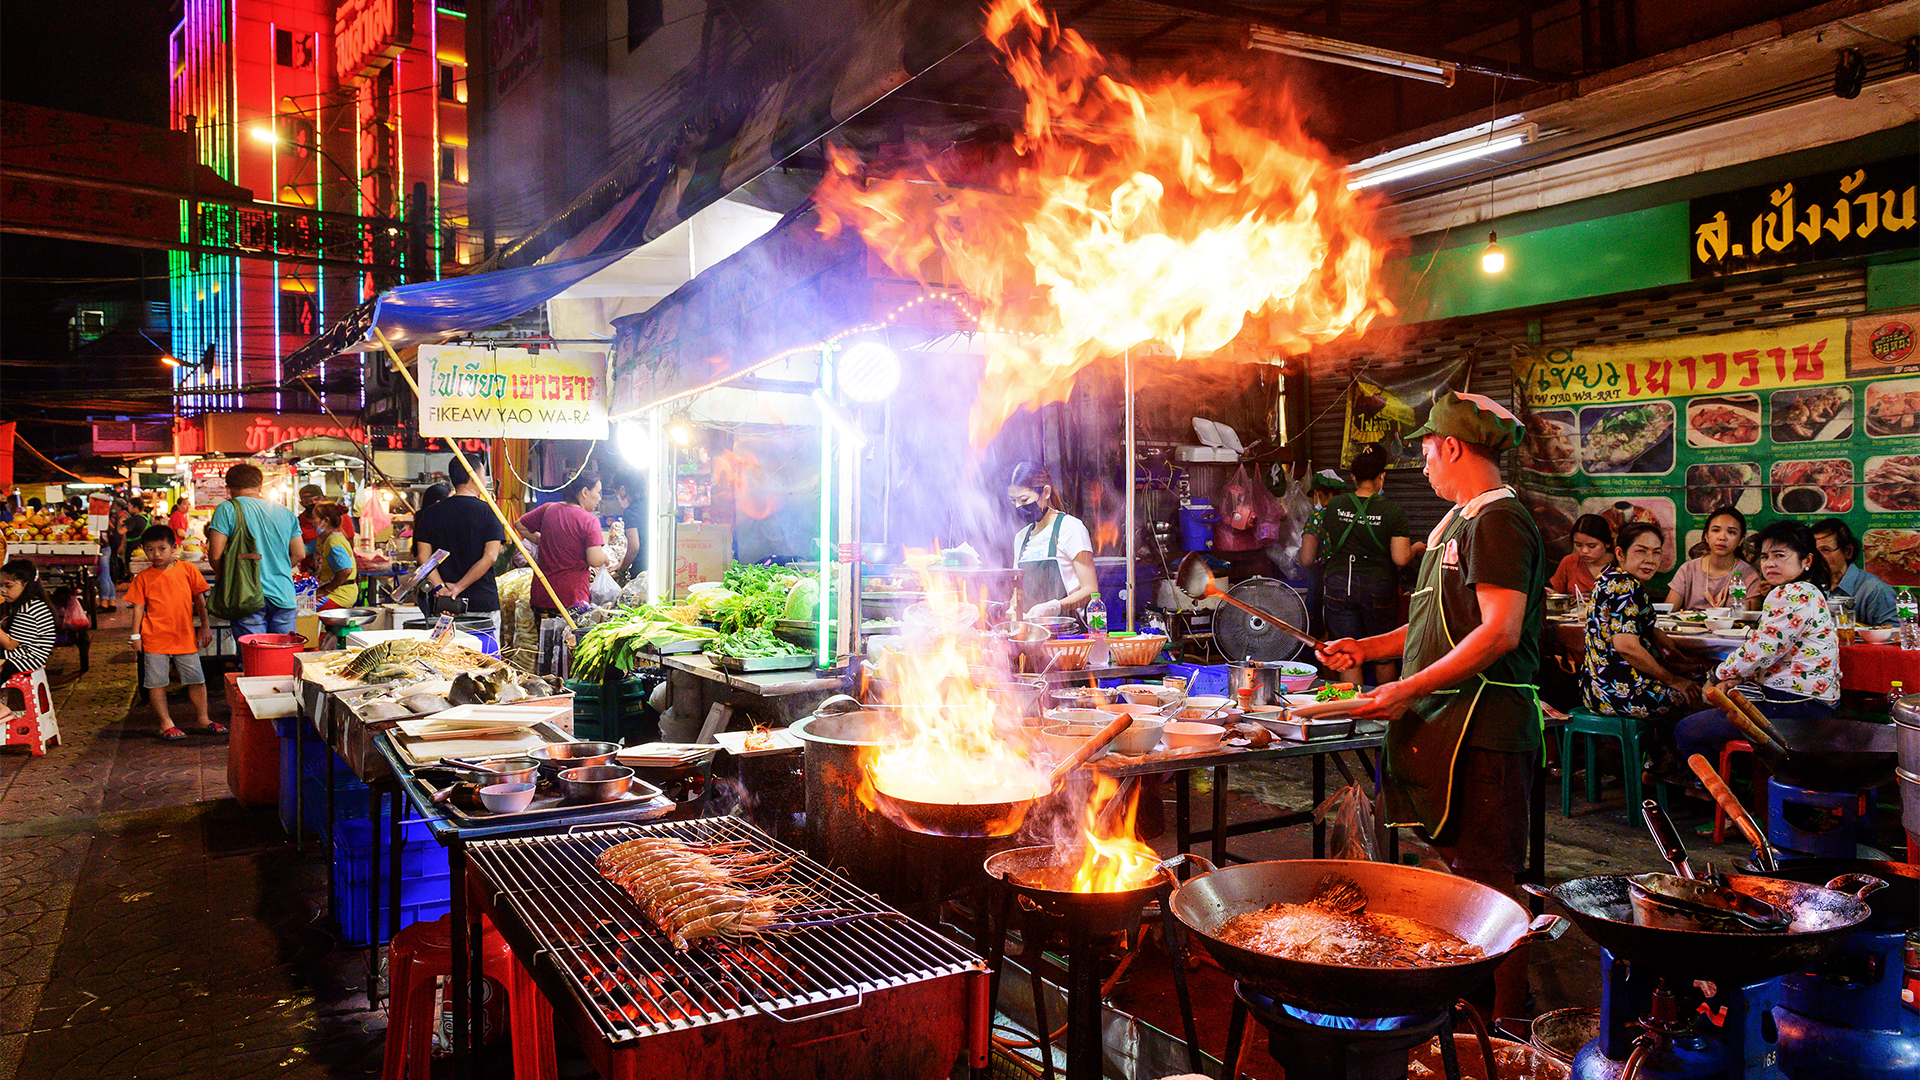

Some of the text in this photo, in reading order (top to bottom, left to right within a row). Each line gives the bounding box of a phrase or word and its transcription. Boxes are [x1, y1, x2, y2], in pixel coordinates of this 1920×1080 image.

[425, 357, 508, 398] ไฟเขียว
[1626, 337, 1828, 396] เยาวราช
[1572, 388, 1622, 402] WA-RAT
[429, 407, 593, 425] FIKEAW YAO WA-RA
